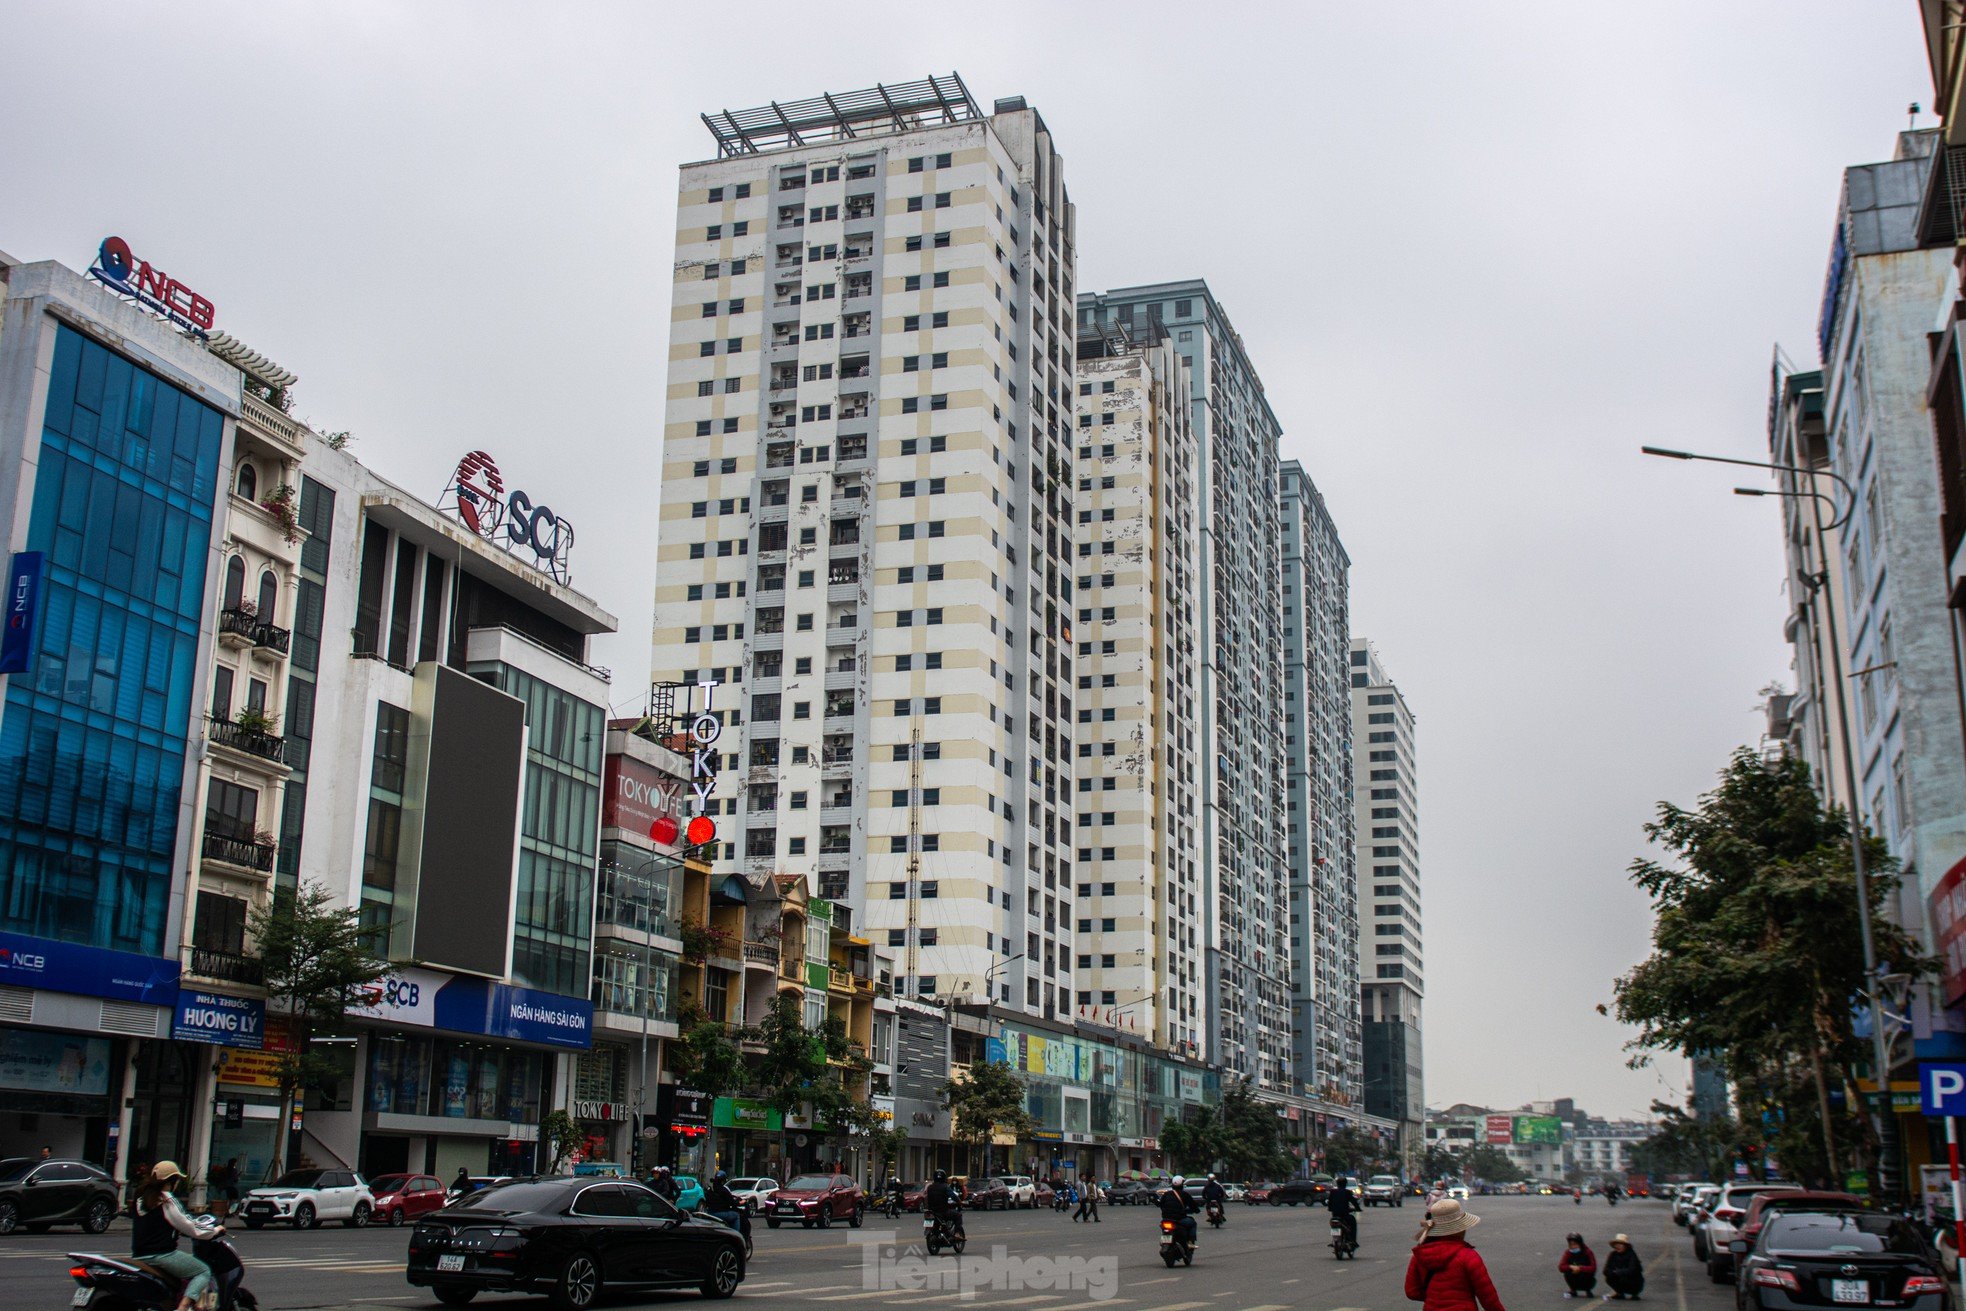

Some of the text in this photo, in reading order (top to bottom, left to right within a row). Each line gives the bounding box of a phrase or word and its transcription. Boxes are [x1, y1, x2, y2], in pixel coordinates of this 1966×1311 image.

[138, 261, 215, 330] NCB
[15, 575, 28, 612] NCB
[12, 952, 45, 968] NCB
[196, 994, 249, 1010] NHÀ THUỐC
[387, 979, 419, 1007] SCB
[184, 1008, 237, 1031] HƯƠNG
[241, 1011, 257, 1033] LÝ
[511, 1003, 586, 1029] NGÂN HÀNG SÀI GÒN
[1931, 1070, 1965, 1108] P
